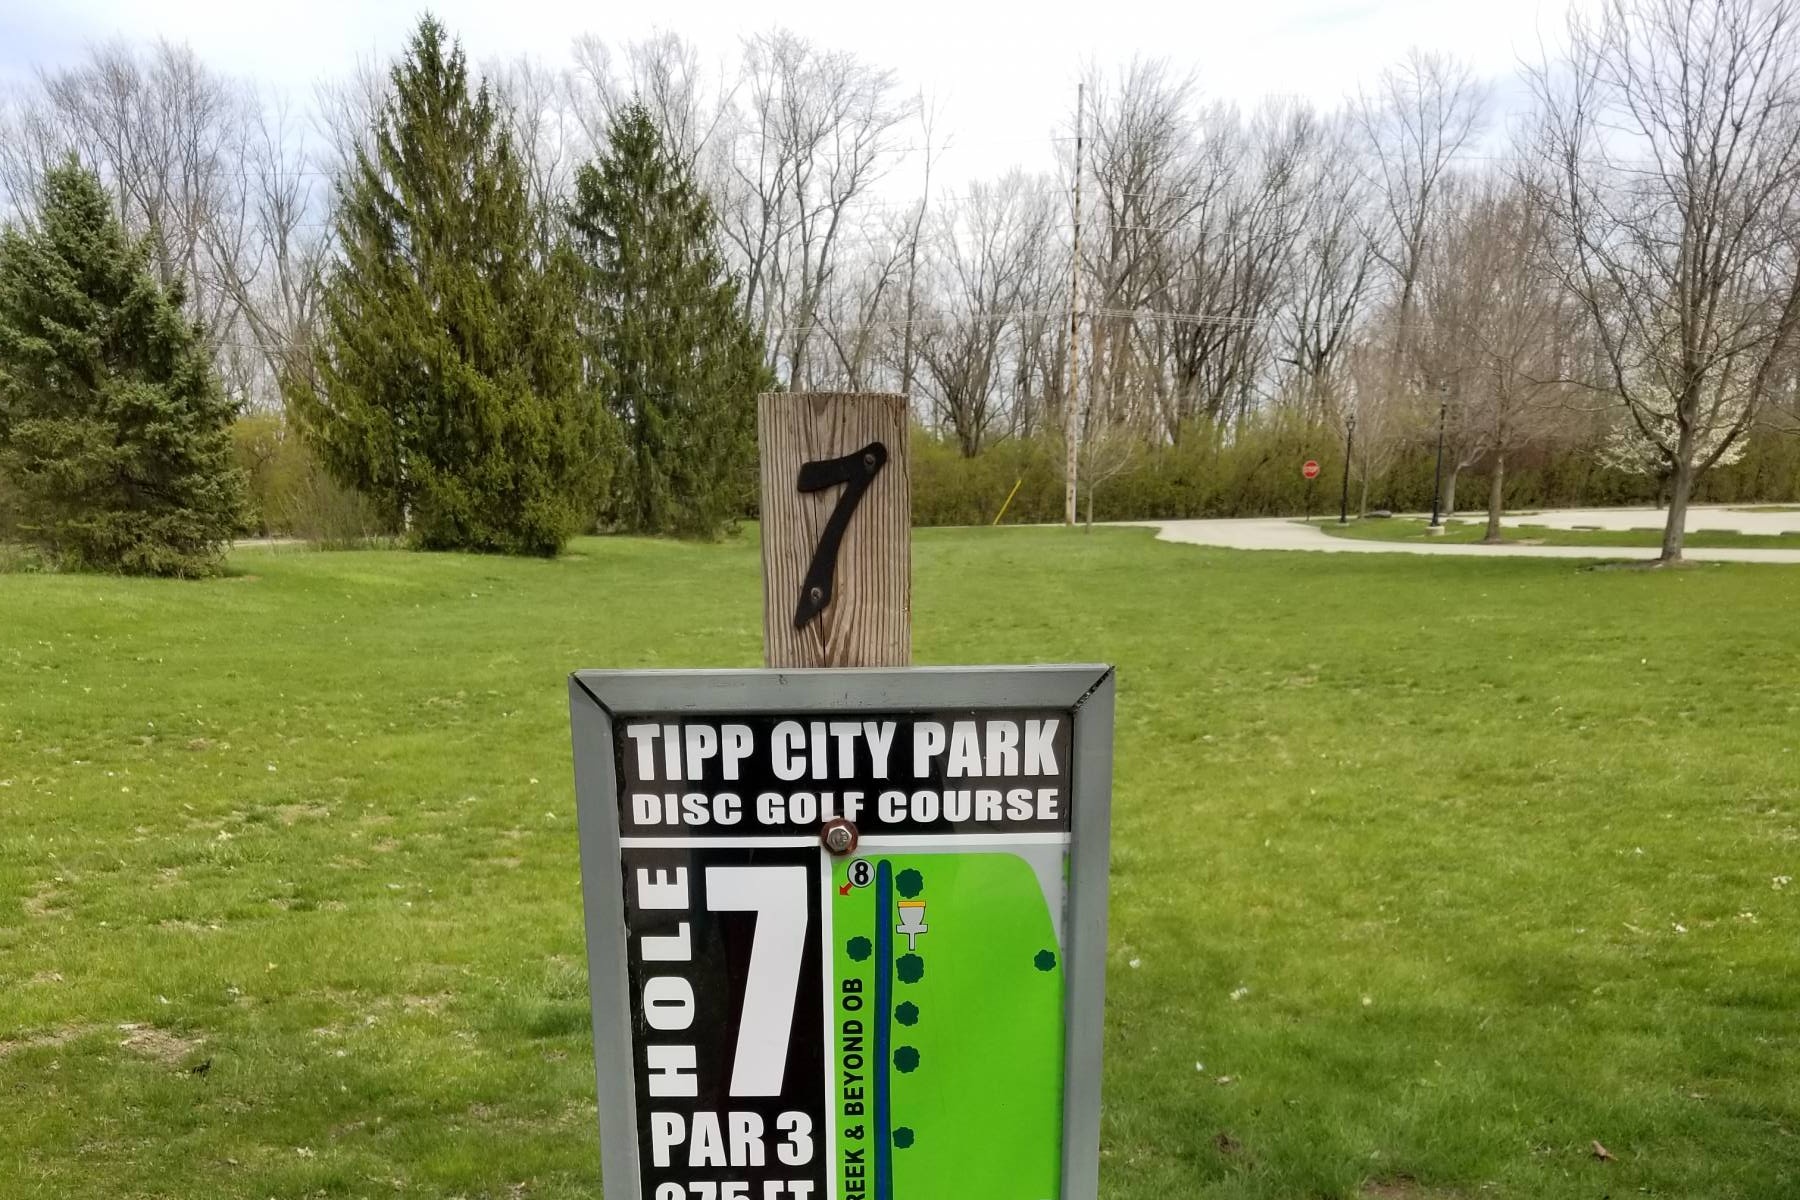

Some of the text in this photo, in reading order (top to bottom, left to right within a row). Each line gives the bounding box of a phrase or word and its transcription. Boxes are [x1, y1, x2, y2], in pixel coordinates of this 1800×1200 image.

[794, 441, 888, 630] 7
[627, 719, 1060, 781] TIPP CITY PARK
[632, 788, 1060, 825] DISC GOLF COURSE
[854, 861, 869, 885] 8
[636, 866, 699, 1098] HOLE
[705, 865, 809, 1097] 7
[842, 978, 863, 1012] OB
[843, 1019, 865, 1116] BEYOND
[650, 1110, 814, 1168] PAR 3
[844, 1124, 865, 1141] &
